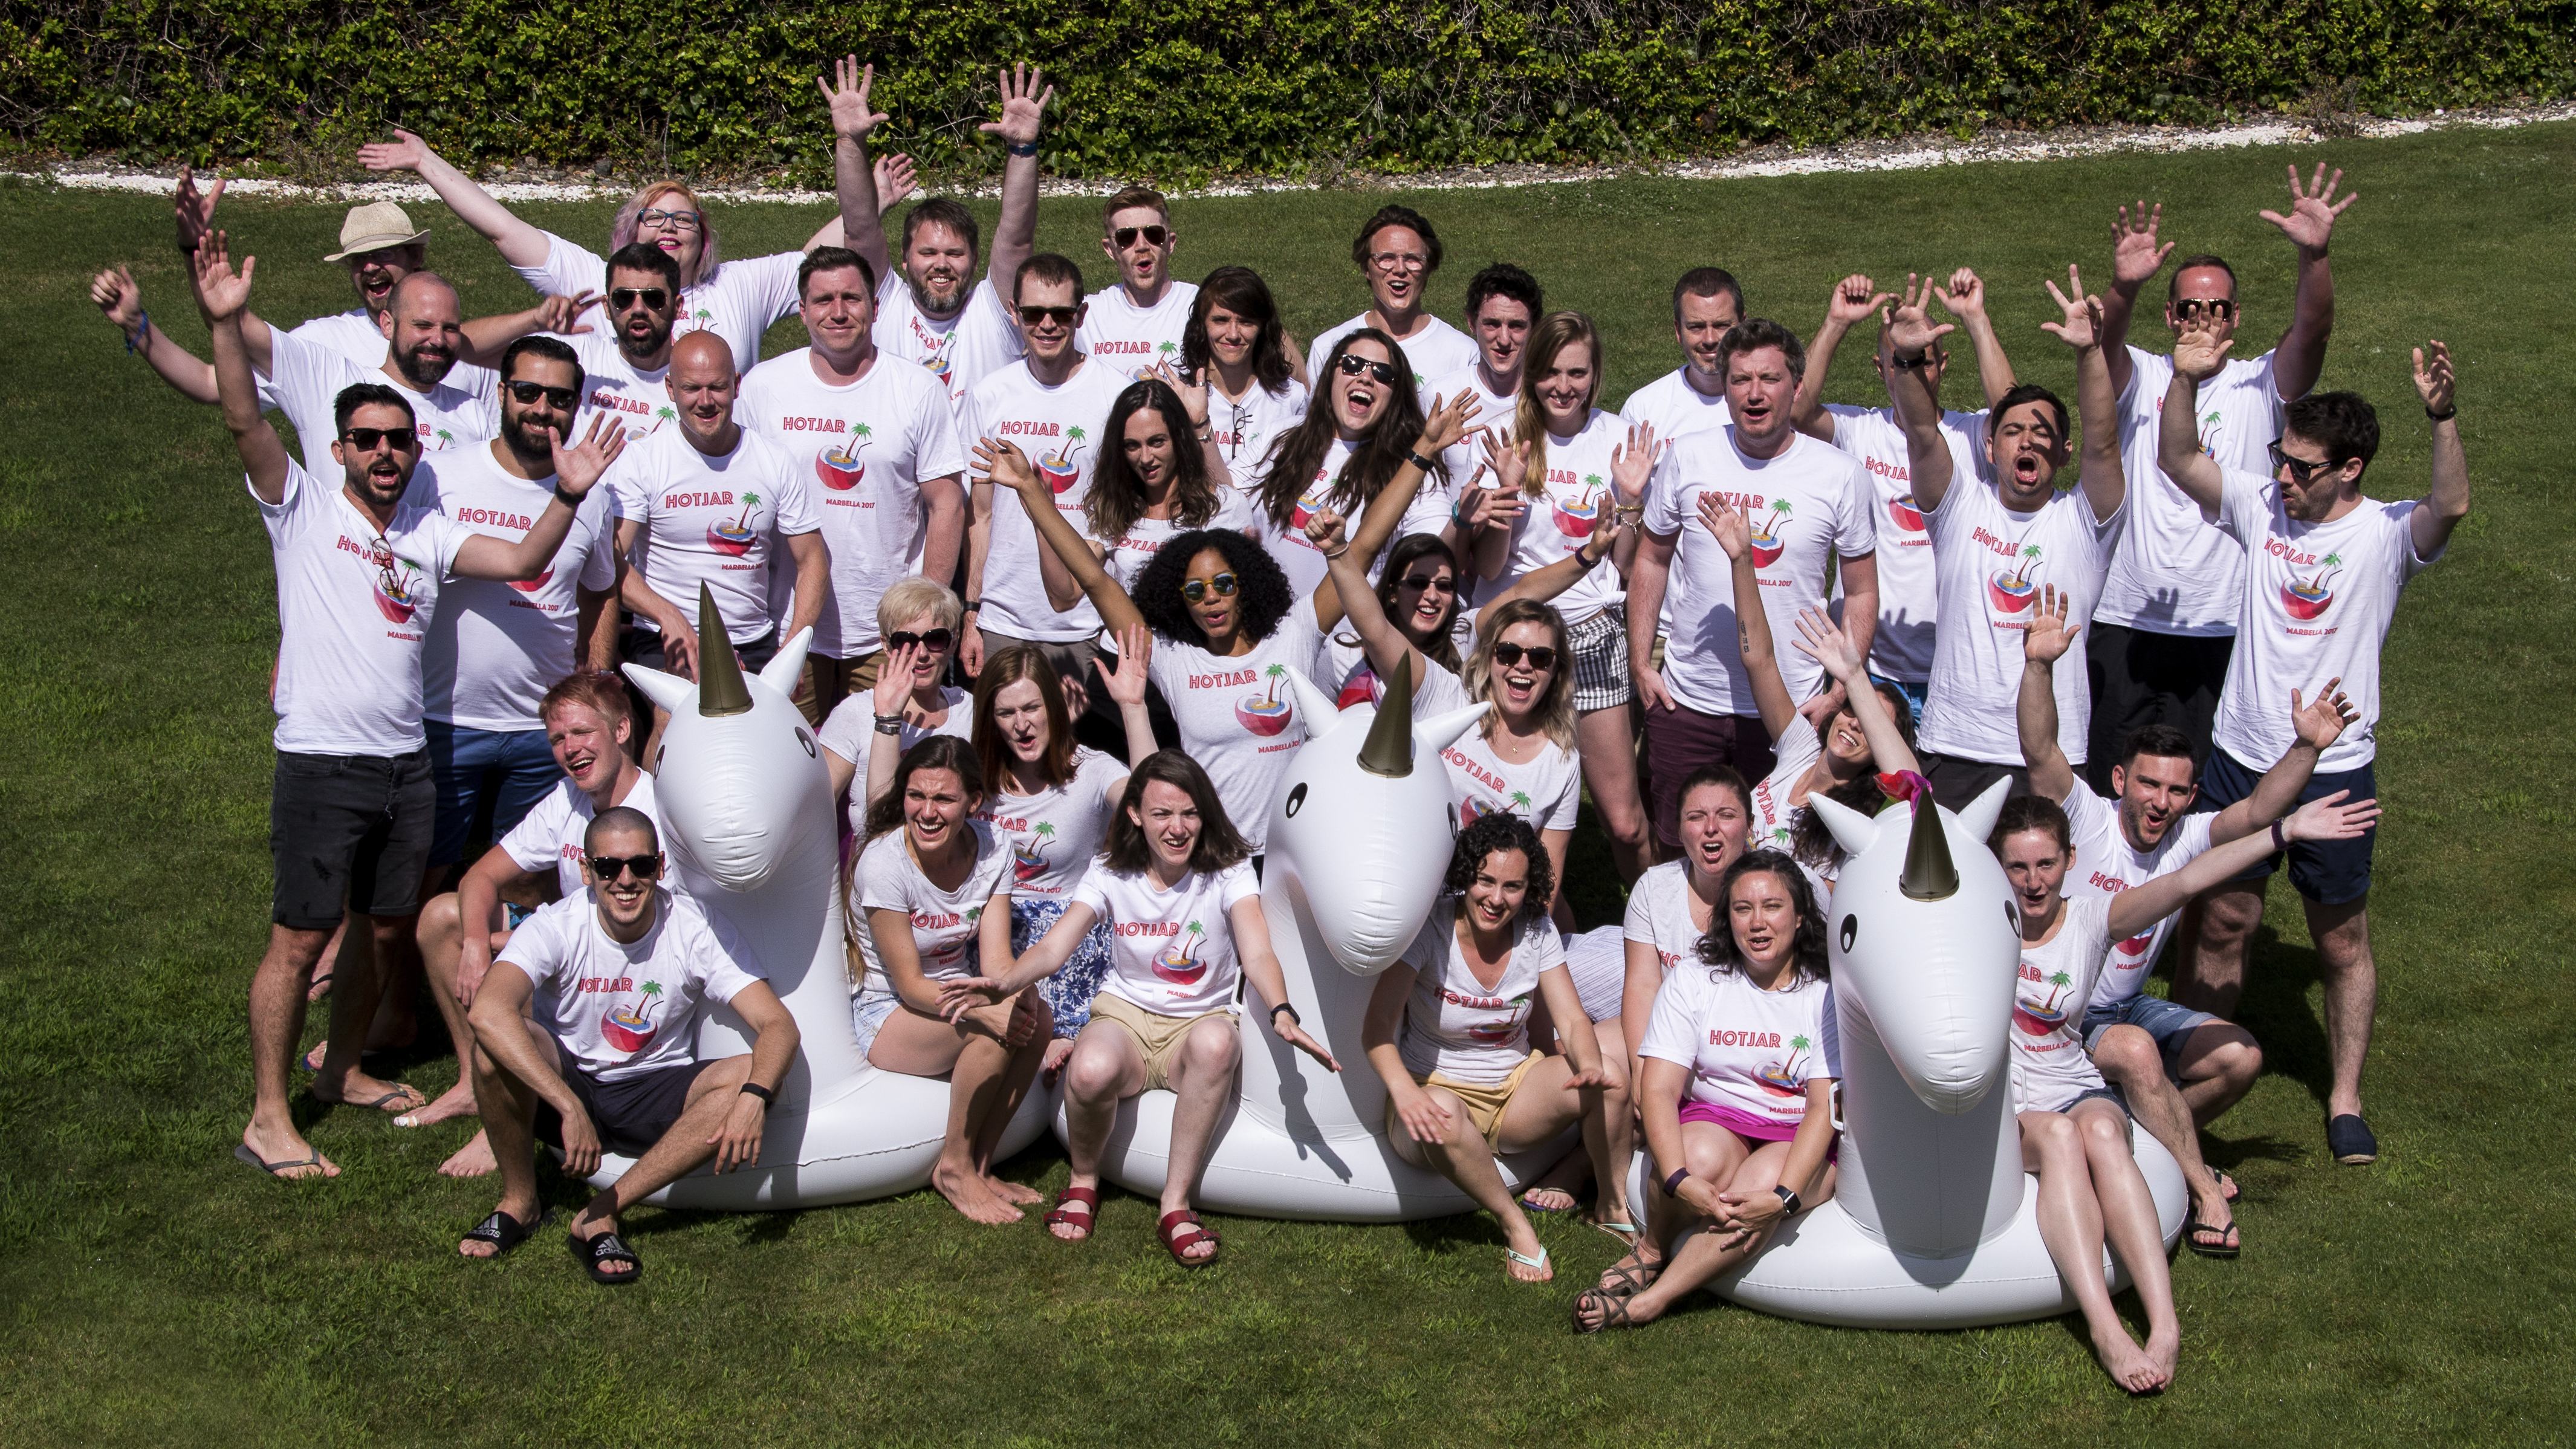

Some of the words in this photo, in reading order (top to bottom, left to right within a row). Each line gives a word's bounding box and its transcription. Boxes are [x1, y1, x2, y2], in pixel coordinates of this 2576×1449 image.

[1094, 342, 1151, 355] HOTJAR
[589, 391, 649, 415] HOTJAR
[784, 417, 845, 433] HOTJAR
[1001, 421, 1060, 436] HOTJAR
[1866, 456, 1911, 480] HOTJA
[666, 491, 734, 508] HOTJAR
[826, 499, 860, 507] MARBELLA
[458, 507, 531, 531] HOTJAR
[510, 600, 547, 610] MARBELLA
[1994, 621, 2023, 629] MARBEL
[1190, 670, 1257, 689] HOTJAR
[1258, 742, 1292, 753] MARBELLA
[1440, 747, 1505, 794] HOTJAR
[1114, 922, 1179, 936] HOTJAR
[579, 977, 632, 993] HOTJAR
[1434, 987, 1504, 1008] HOTJAR
[1710, 1030, 1780, 1048] HOTJAR
[2024, 1043, 2060, 1052] MARBELLA
